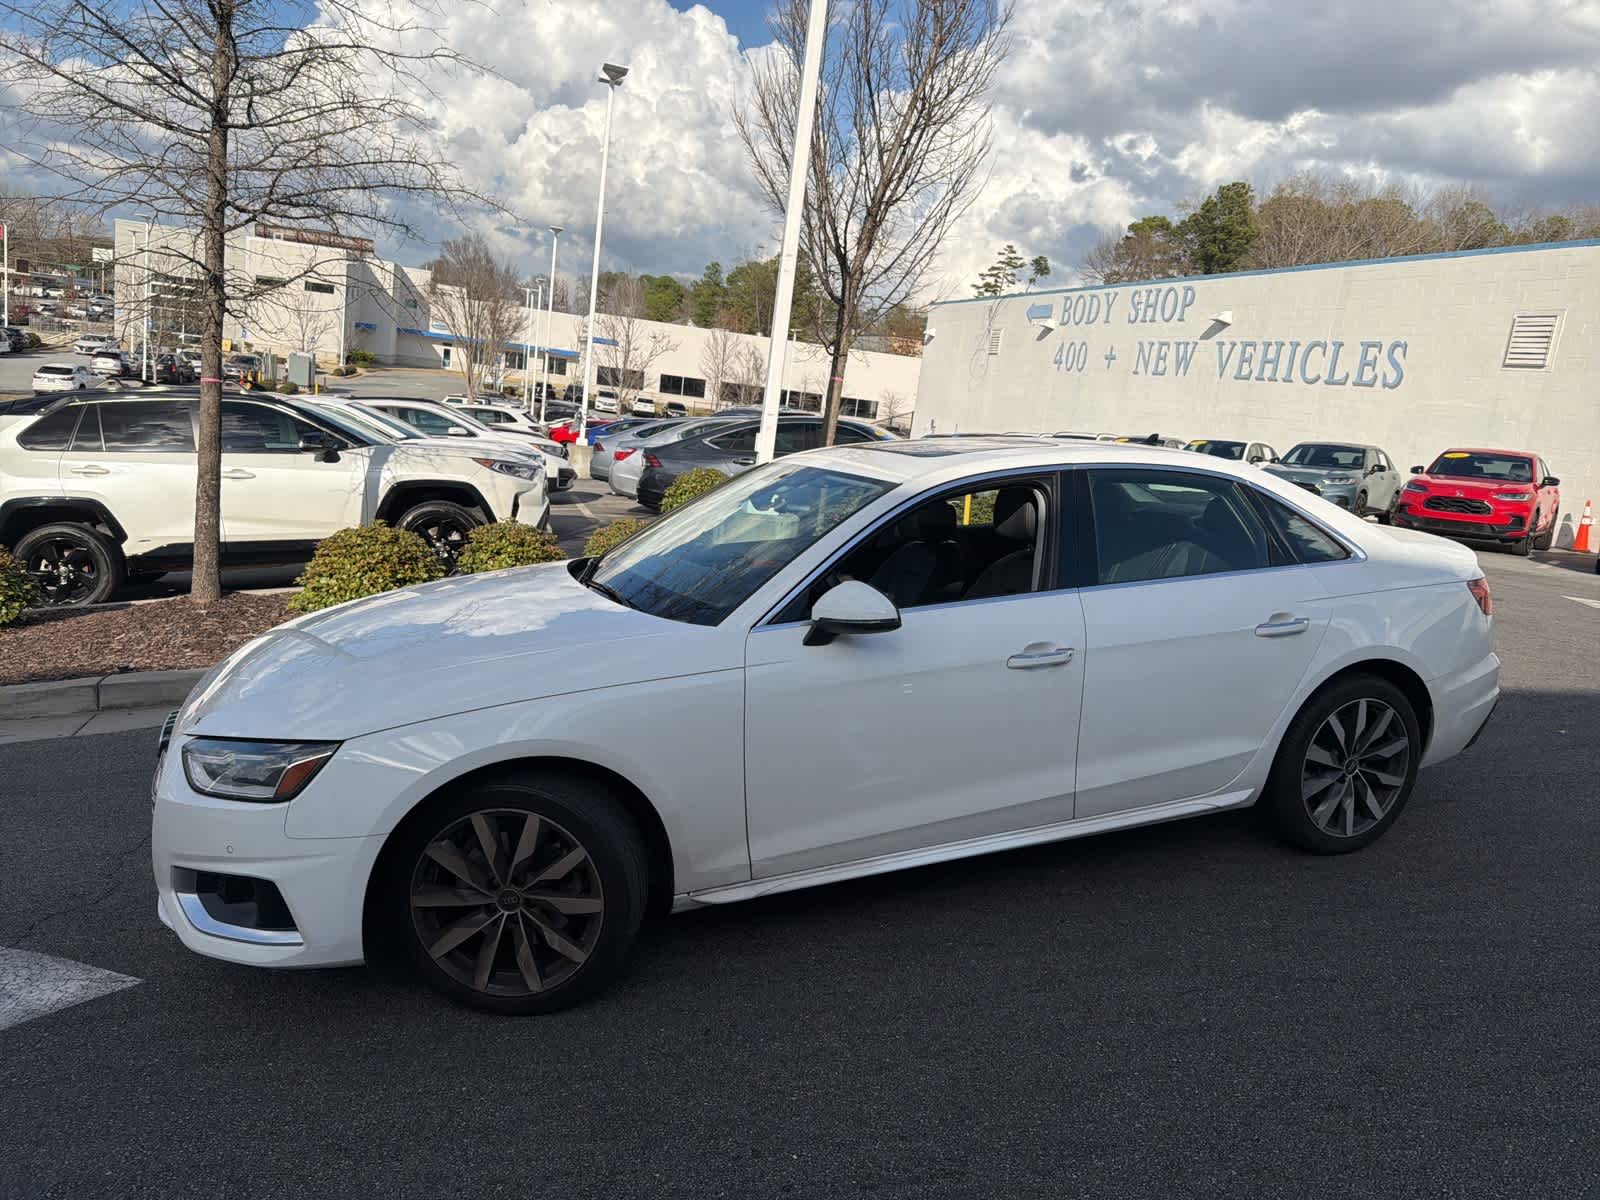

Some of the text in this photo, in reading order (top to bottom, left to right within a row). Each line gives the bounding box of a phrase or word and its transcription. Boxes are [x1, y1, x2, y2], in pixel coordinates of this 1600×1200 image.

[1059, 285, 1196, 326] BODY SHOP
[1053, 340, 1408, 390] 400 + NEW VEHICLES
